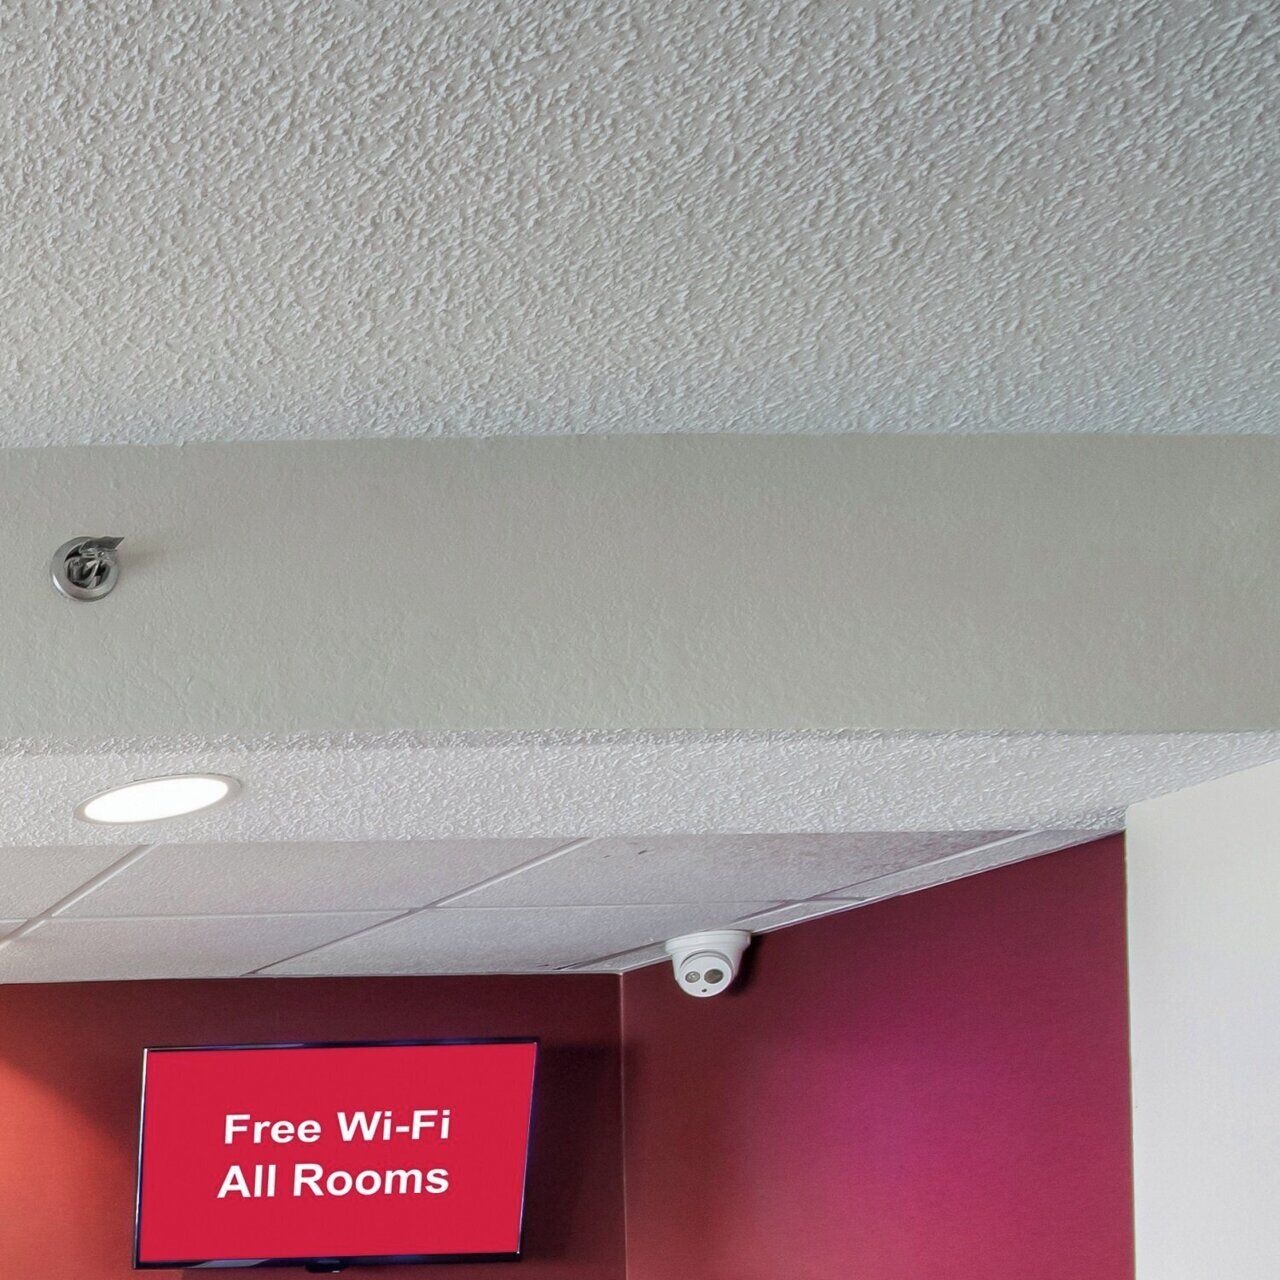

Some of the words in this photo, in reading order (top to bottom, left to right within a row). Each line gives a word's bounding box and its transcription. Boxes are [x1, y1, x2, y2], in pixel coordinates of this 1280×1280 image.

[224, 1114, 322, 1145] Free
[337, 1109, 451, 1142] Wi-Fi
[217, 1164, 277, 1199] All
[293, 1163, 449, 1197] Rooms
